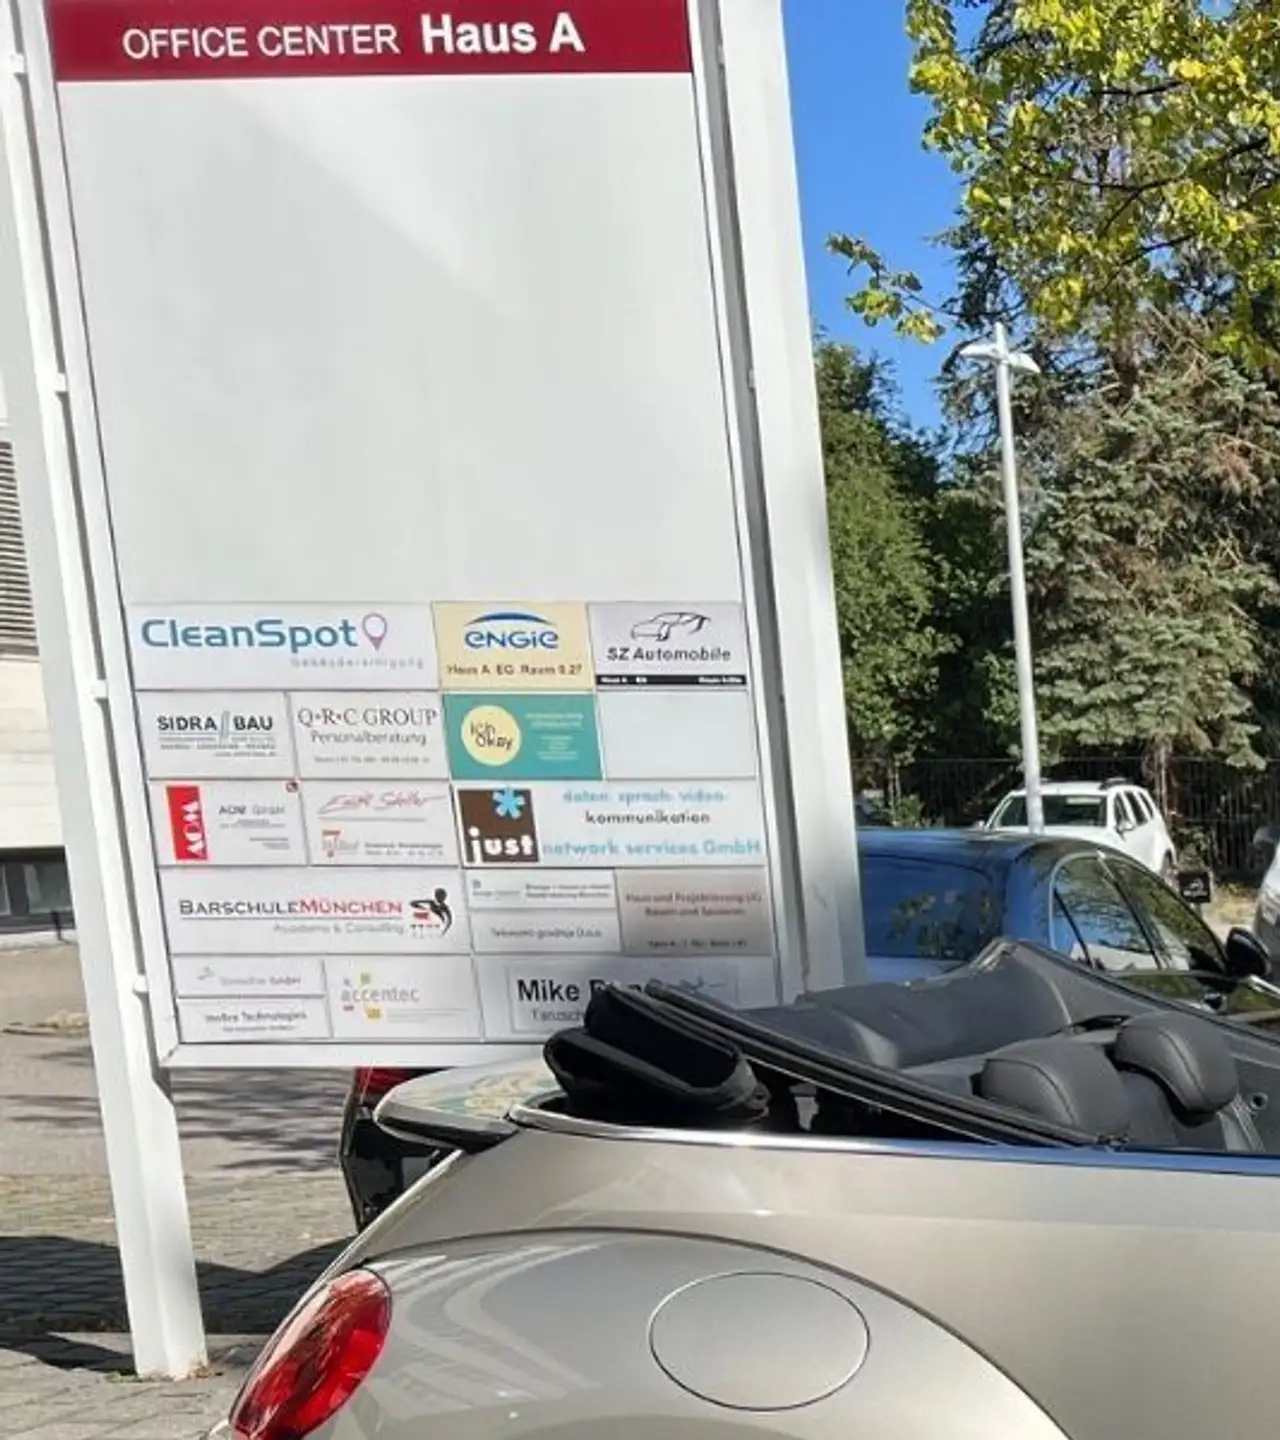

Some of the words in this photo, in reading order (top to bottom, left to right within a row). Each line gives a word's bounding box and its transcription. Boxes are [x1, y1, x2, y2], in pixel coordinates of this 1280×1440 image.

[122, 27, 249, 59] OFFICE
[256, 24, 401, 57] CENTER
[419, 13, 538, 54] Haus
[548, 12, 586, 53] A
[140, 619, 358, 654] CleanSpot
[606, 648, 630, 662] SZ
[632, 647, 732, 662] Automobile
[156, 715, 218, 732] SIDRA
[232, 714, 274, 732] BAU
[362, 706, 439, 727] GROUP
[468, 827, 535, 864] just
[516, 978, 581, 1002] Mike
